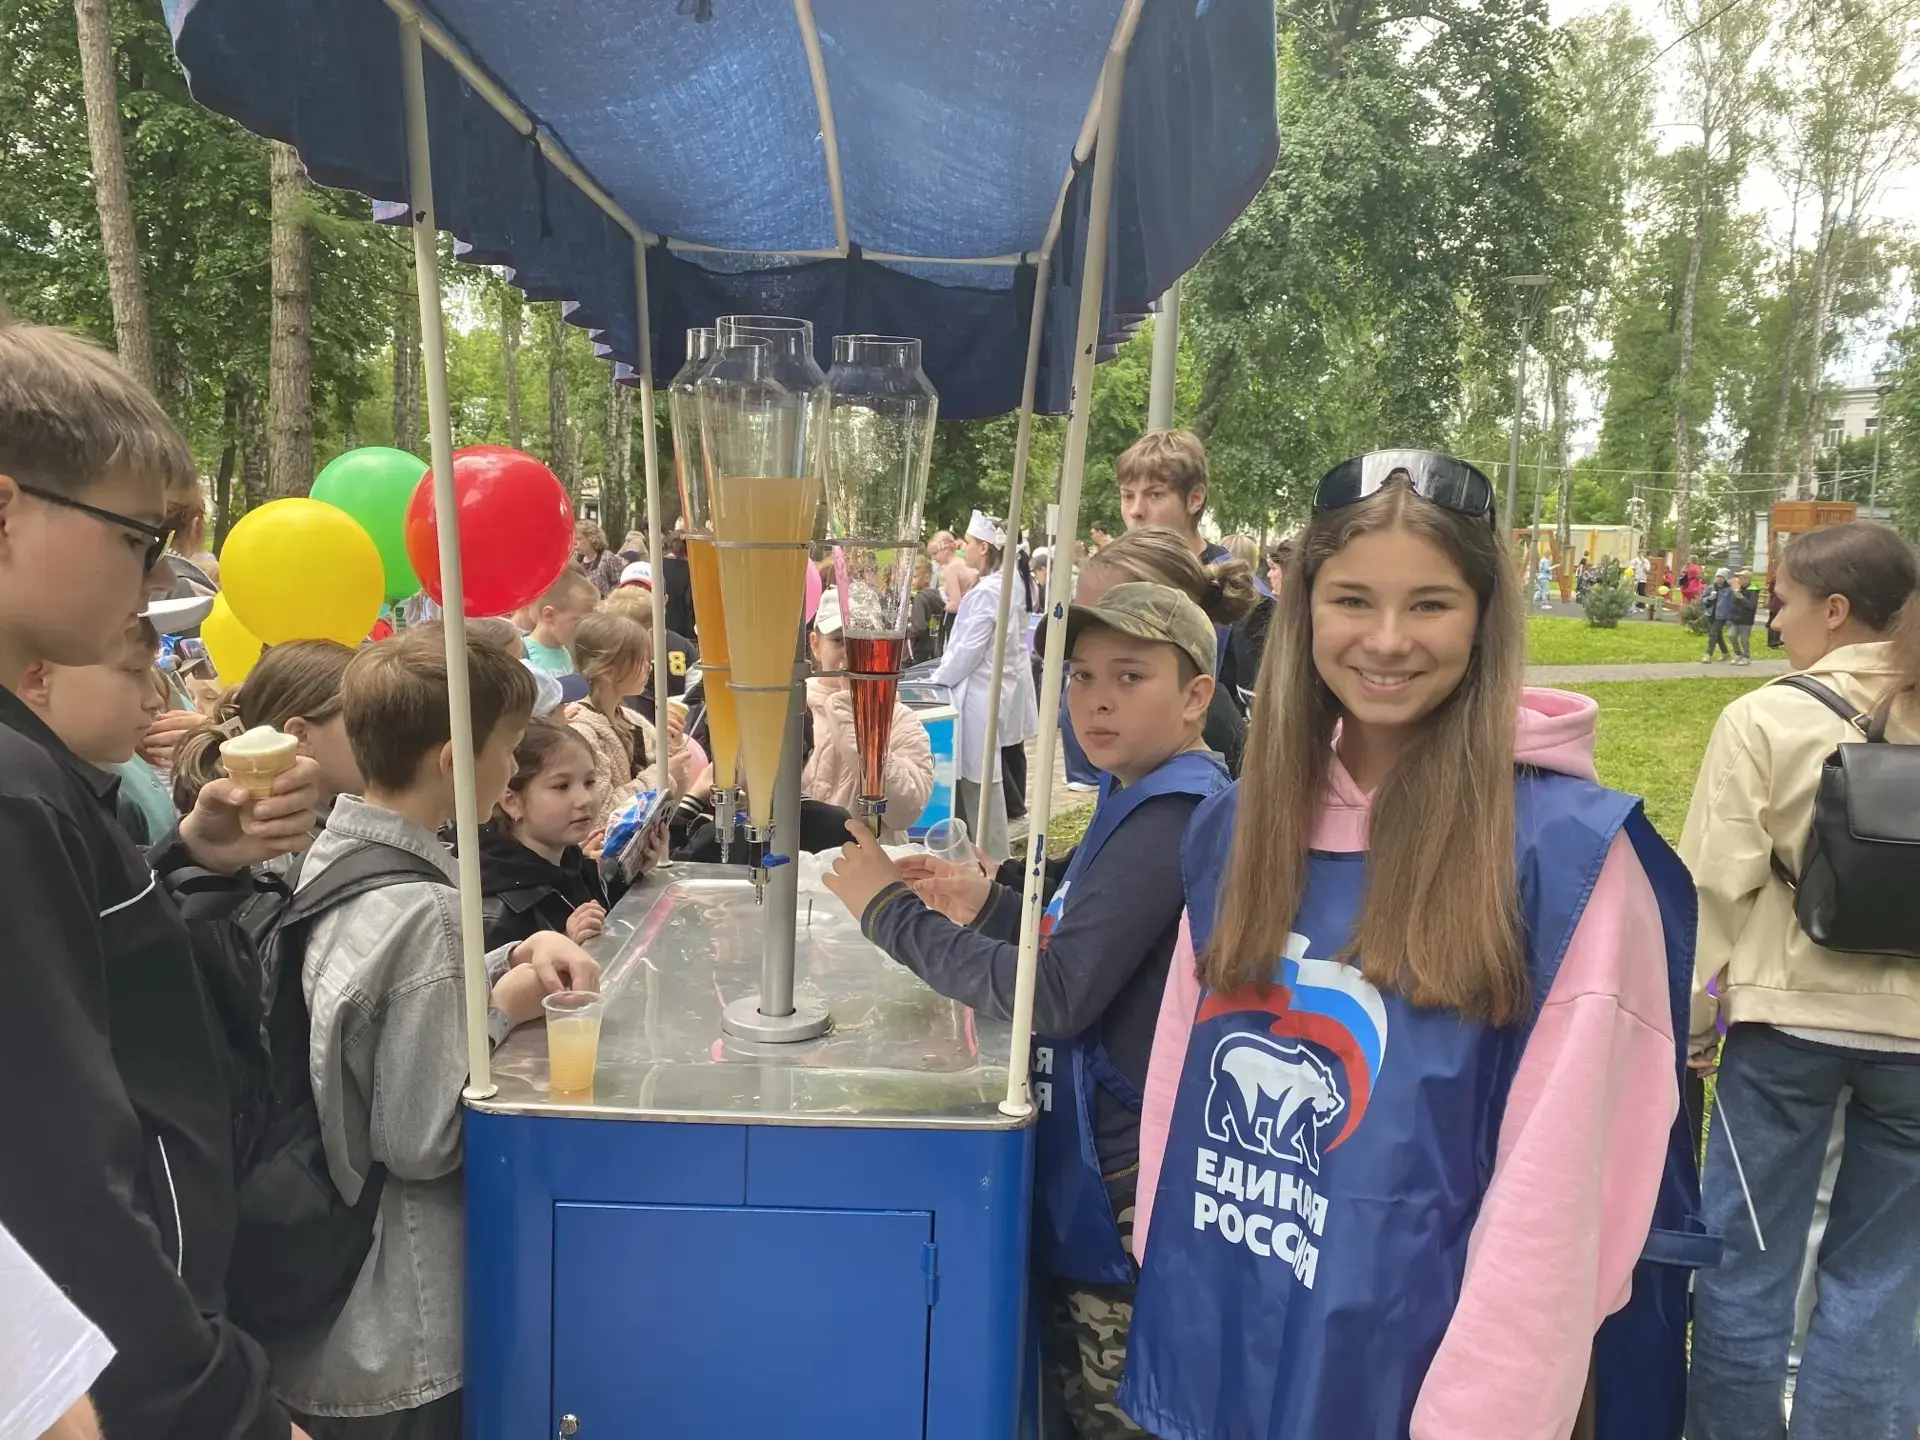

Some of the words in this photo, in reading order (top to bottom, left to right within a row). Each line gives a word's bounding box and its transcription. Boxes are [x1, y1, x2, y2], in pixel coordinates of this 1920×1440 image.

[668, 650, 687, 677] 8
[1195, 1146, 1329, 1237] ЕДИНАЯ
[1193, 1191, 1320, 1290] РОССИЯ
